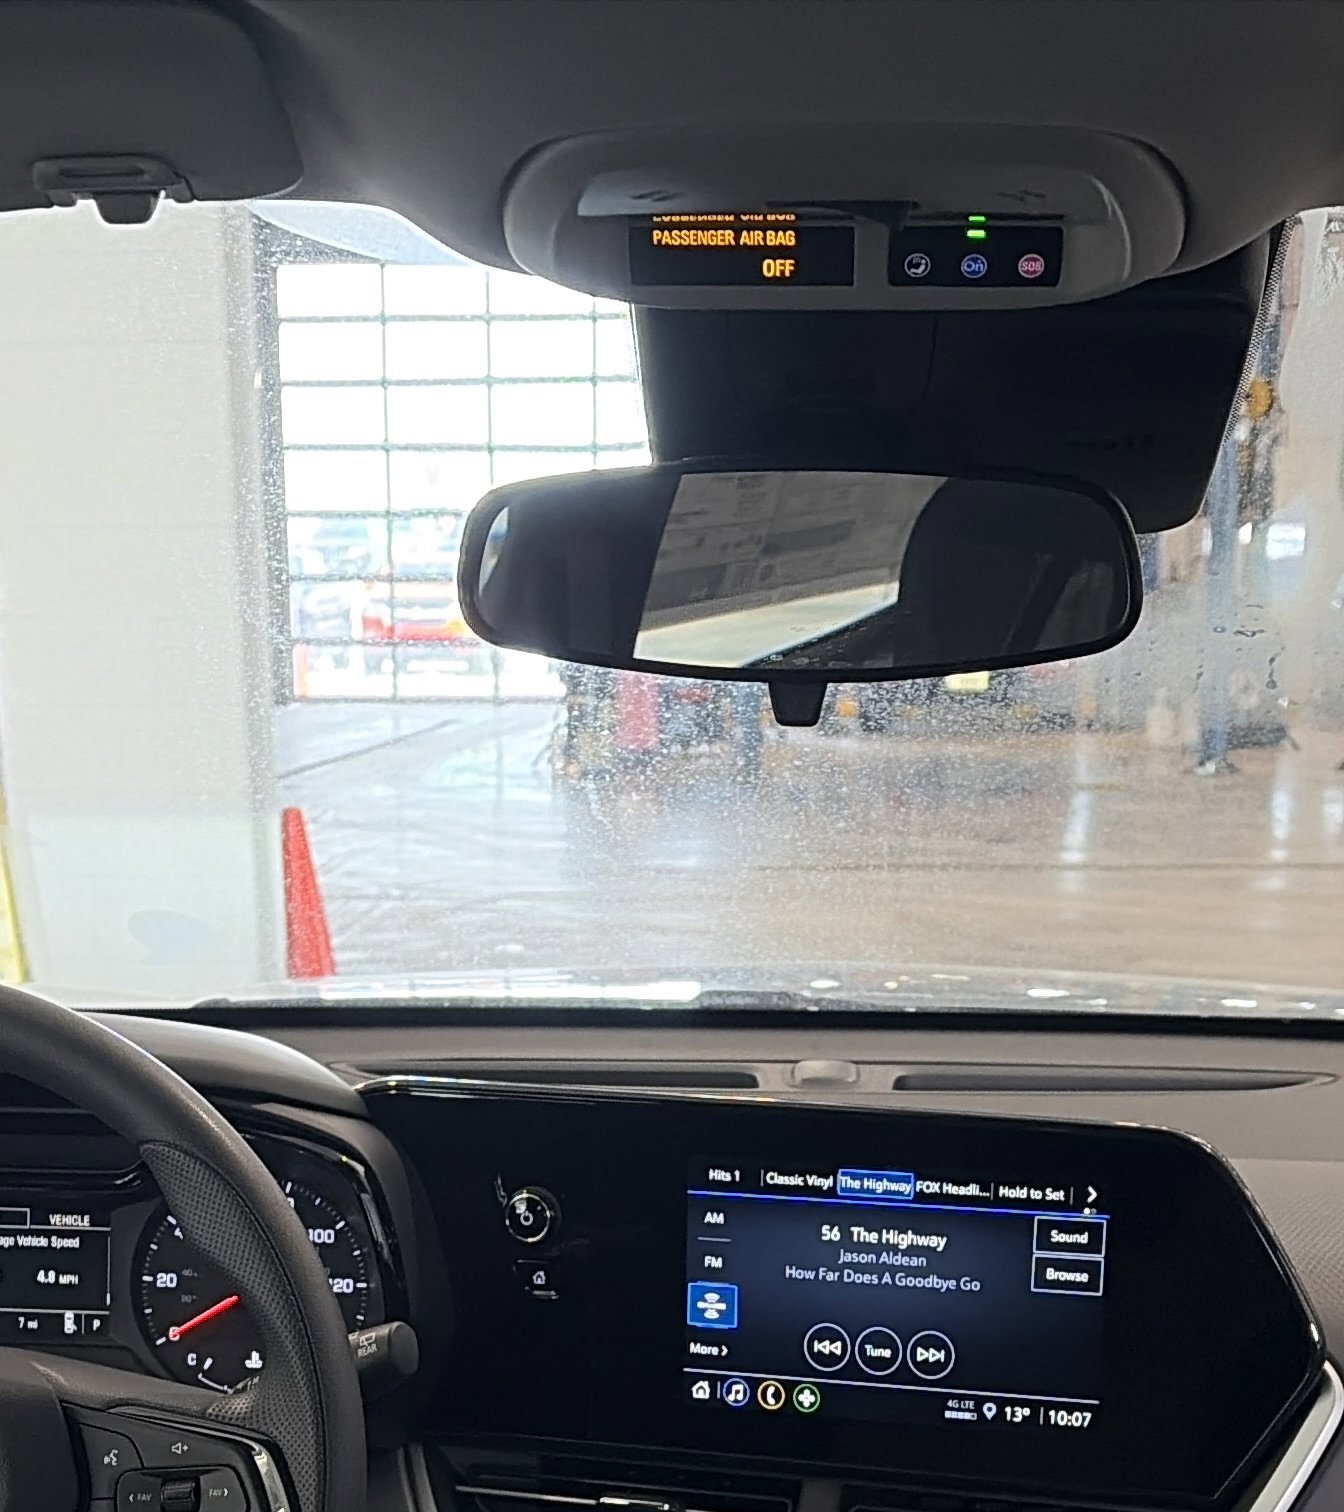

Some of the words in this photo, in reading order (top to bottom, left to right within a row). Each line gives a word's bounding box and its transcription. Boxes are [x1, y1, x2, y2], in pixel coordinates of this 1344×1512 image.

[653, 229, 736, 246] PASSENGER
[740, 229, 765, 246] AIR
[766, 229, 796, 246] BAG
[762, 258, 796, 278] OFF
[1021, 260, 1041, 271] SOS
[709, 1169, 731, 1181] Hits
[734, 1170, 740, 1182] 1
[766, 1172, 805, 1186] Classic
[806, 1175, 833, 1190] Vinyl
[840, 1176, 860, 1189] The
[863, 1178, 911, 1194] Highway
[916, 1181, 940, 1193] FOX
[999, 1185, 1027, 1199] Hold
[1030, 1188, 1042, 1199] to
[1045, 1188, 1065, 1201] Set
[49, 1214, 90, 1226] VEHICLE
[704, 1212, 724, 1224] AM
[17, 1235, 48, 1248] Vehicle
[51, 1236, 80, 1249] Speed
[308, 1229, 335, 1244] 100
[821, 1225, 841, 1241] 56
[850, 1227, 879, 1243] The
[882, 1229, 947, 1251] Highway
[1050, 1230, 1089, 1244] Sound
[704, 1256, 722, 1268] FM
[838, 1249, 876, 1264] Jason
[879, 1251, 927, 1267] Aldean
[59, 1274, 78, 1285] MPH
[156, 1272, 178, 1288] 20
[785, 1265, 816, 1280] How
[819, 1268, 839, 1281] Far
[843, 1269, 878, 1284] Does
[881, 1271, 892, 1285] A
[895, 1272, 956, 1292] Goodbye
[960, 1277, 981, 1291] Go
[1045, 1268, 1089, 1283] Browse
[18, 1317, 25, 1329] 7
[93, 1320, 100, 1331] P
[358, 1343, 377, 1358] REAR
[690, 1342, 719, 1356] More
[864, 1345, 892, 1358] Tune
[188, 1353, 197, 1366] C
[947, 1399, 959, 1409] 4G
[961, 1400, 975, 1410] LTE
[1048, 1410, 1092, 1428] 10:07
[137, 1493, 152, 1502] FAV
[208, 1489, 223, 1498] FAV
